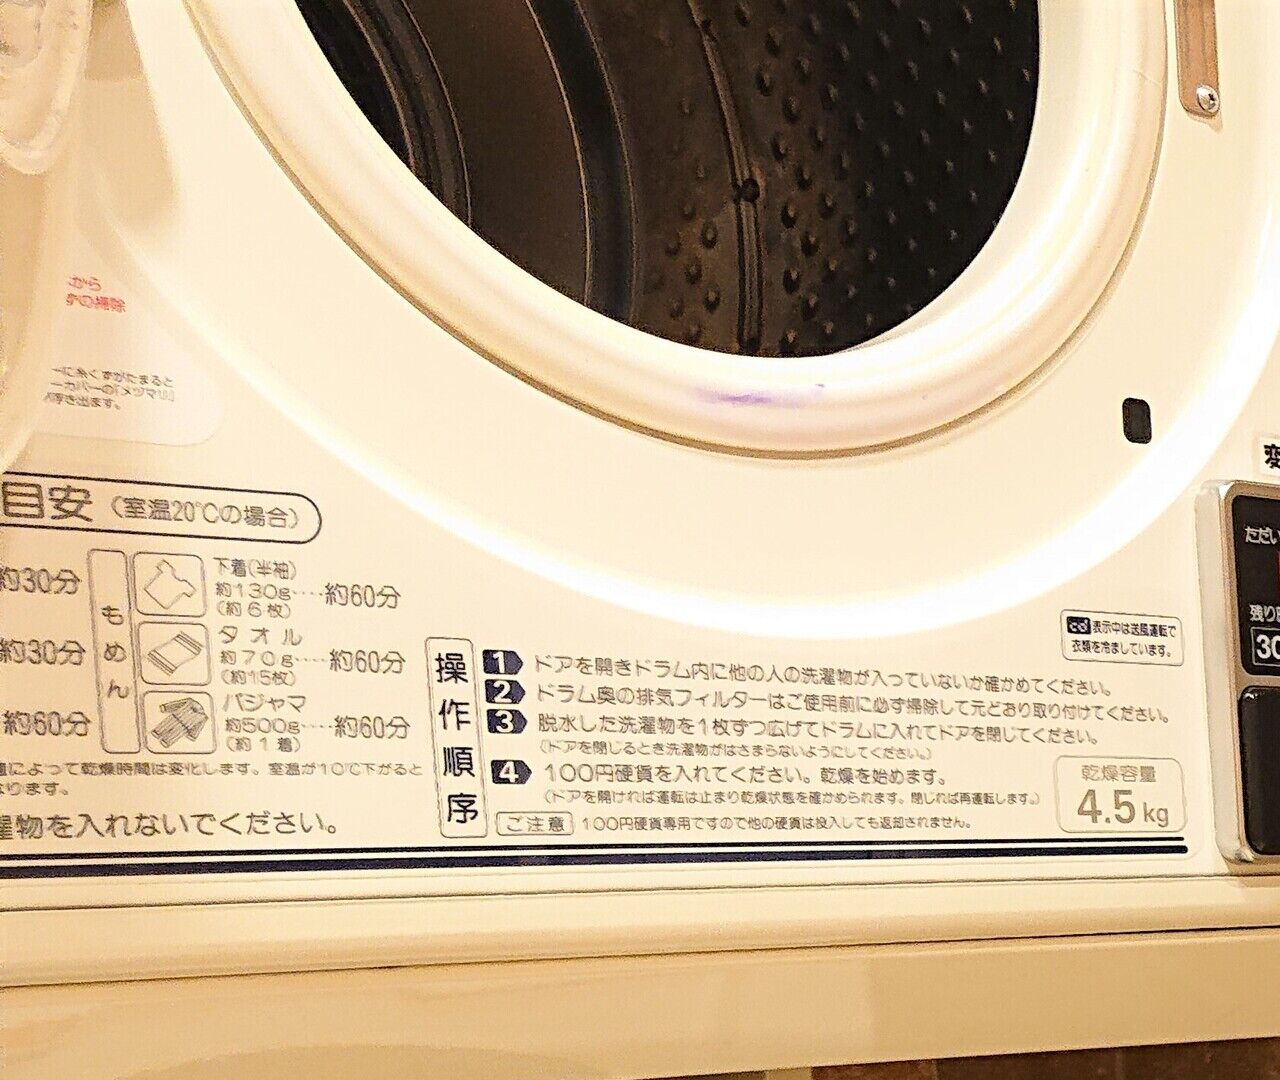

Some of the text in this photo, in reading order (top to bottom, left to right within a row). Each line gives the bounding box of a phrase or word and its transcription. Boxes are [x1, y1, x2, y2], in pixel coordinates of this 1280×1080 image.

[2, 481, 93, 522] 目安
[213, 557, 297, 580] 下着(半袖)
[215, 582, 401, 610] 約130g 約60分
[219, 625, 302, 645] タオル
[0, 639, 85, 666] 約30分
[101, 604, 130, 699] もめん
[1071, 639, 1172, 659] 衣類を冷ましています。
[330, 649, 406, 675] 約60分
[222, 670, 296, 687] (約15枚)
[225, 715, 410, 740] 約500g 約60分
[433, 652, 478, 824] 操作順序
[1081, 764, 1156, 783] 乾燥容量
[0, 781, 69, 796] ります。
[1077, 789, 1169, 828] 4.5 kg
[506, 816, 565, 833] ご注意
